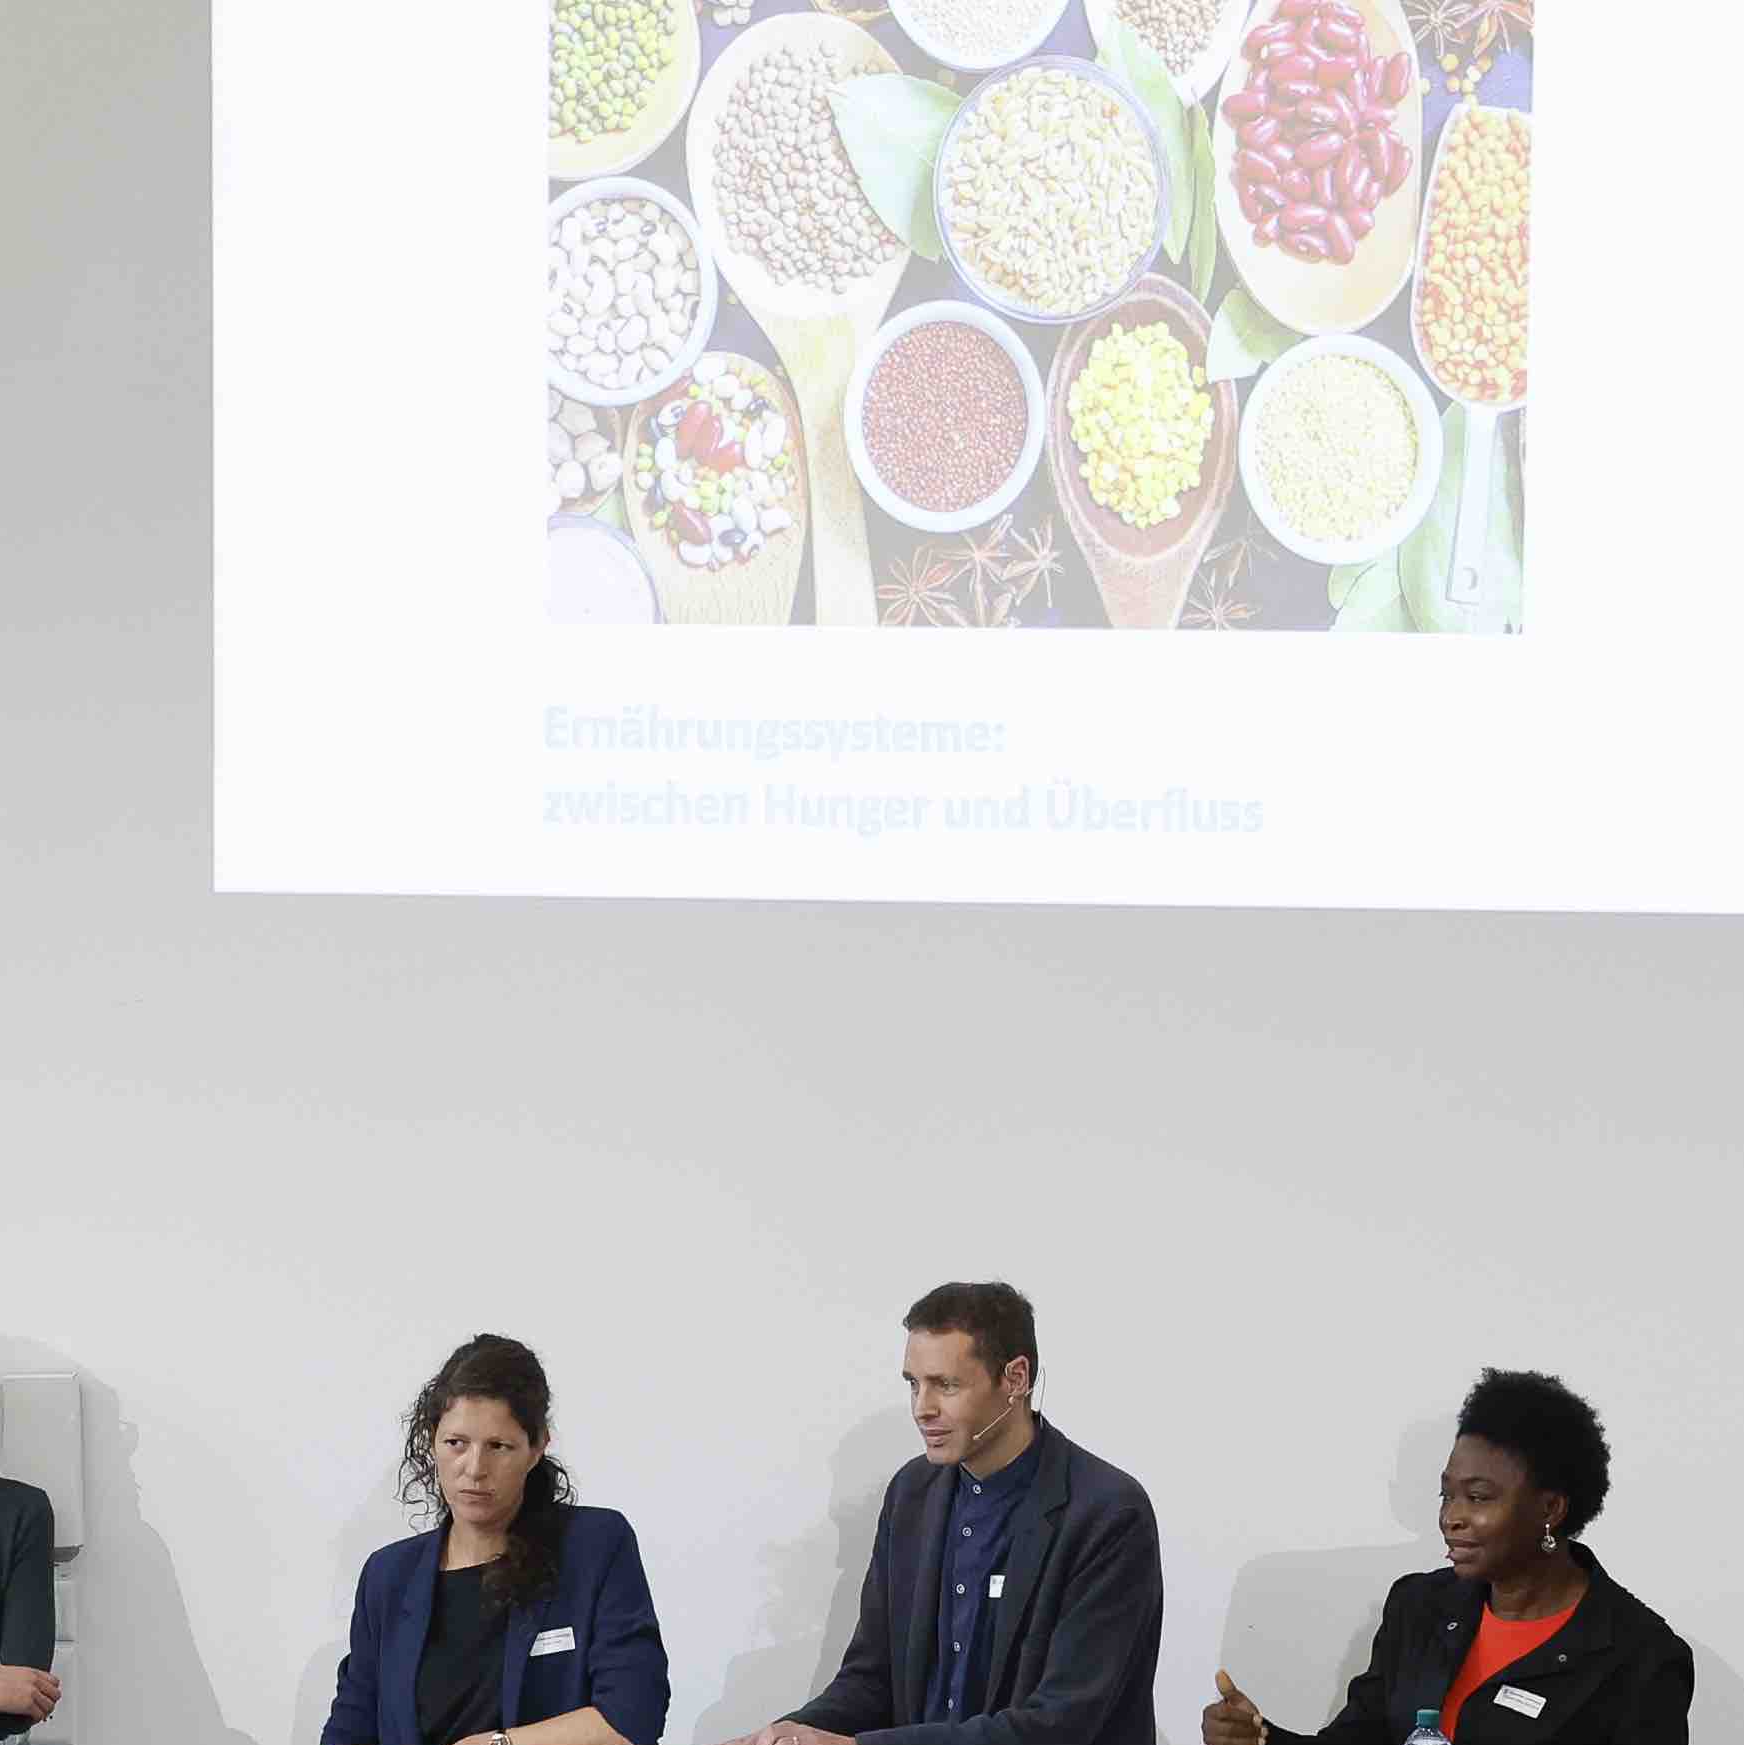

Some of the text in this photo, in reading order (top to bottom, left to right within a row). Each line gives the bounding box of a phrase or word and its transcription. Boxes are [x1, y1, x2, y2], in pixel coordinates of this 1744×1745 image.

[543, 705, 1005, 761] Ernährungssysteme:
[543, 779, 1264, 838] zwischen Hunger und Überfluss
